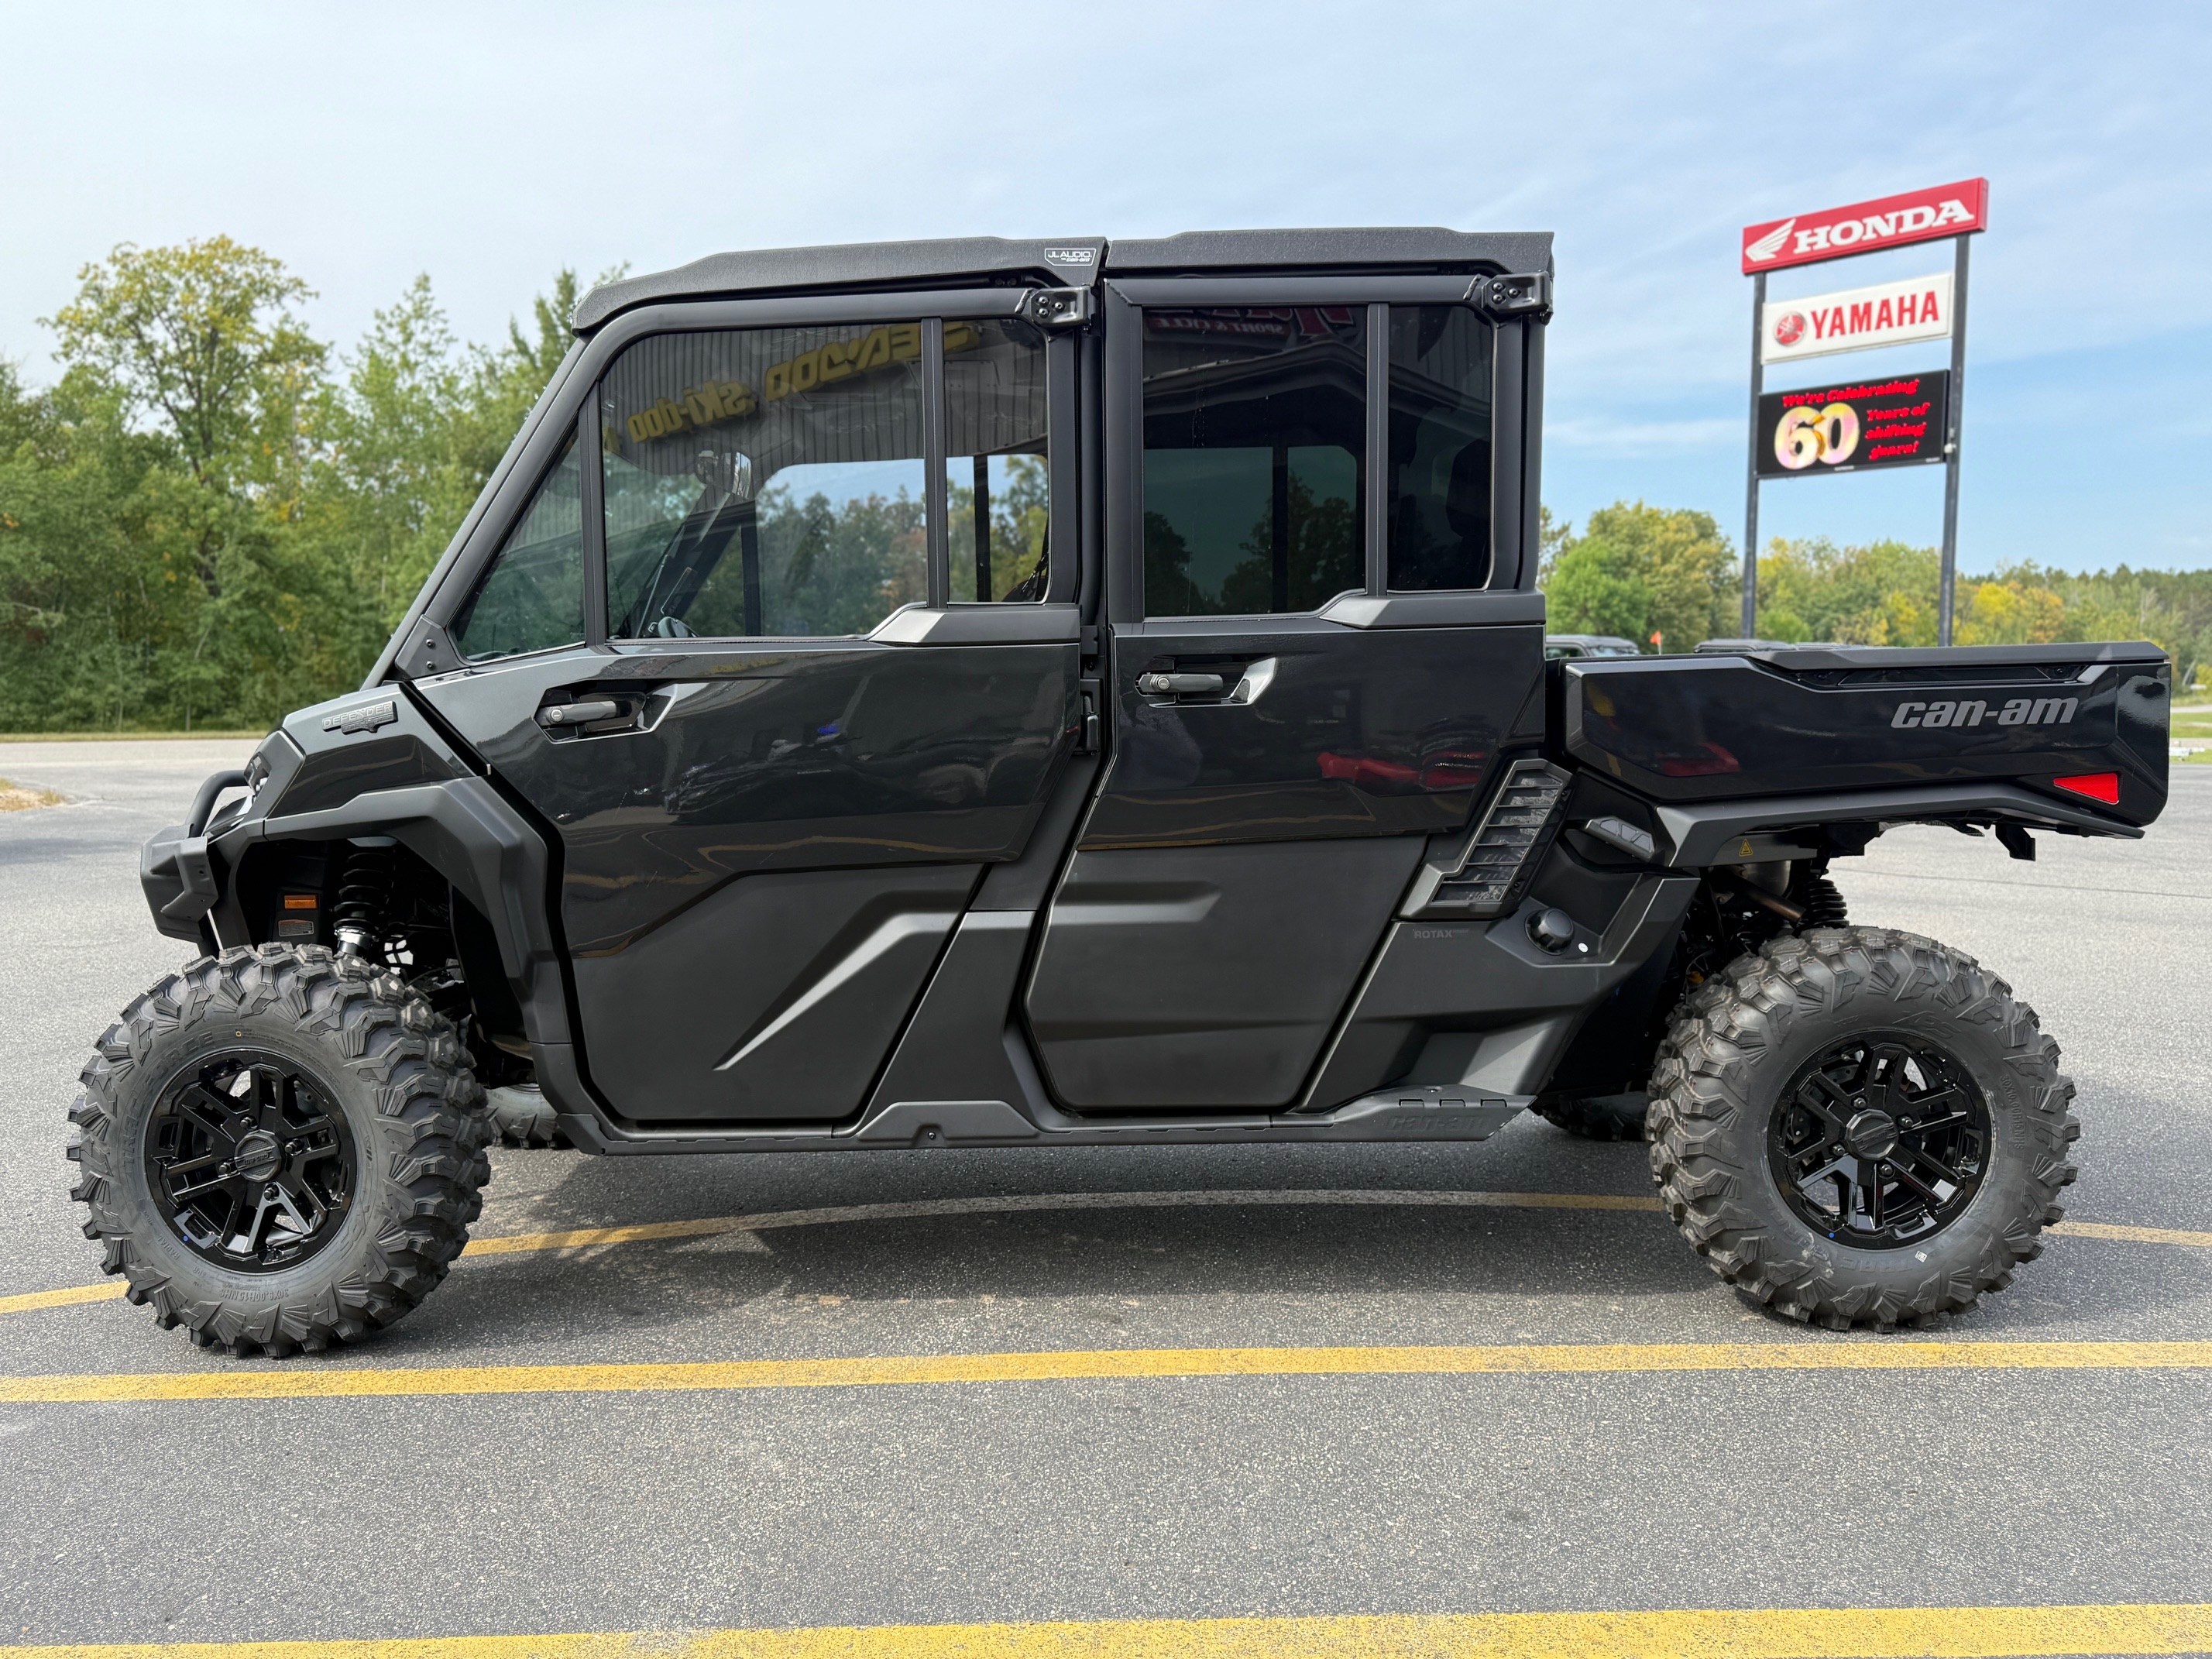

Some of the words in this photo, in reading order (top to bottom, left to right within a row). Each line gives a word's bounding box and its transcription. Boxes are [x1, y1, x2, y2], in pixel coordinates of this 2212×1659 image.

[1793, 199, 1974, 255] HONDA
[1048, 250, 1060, 259] JL
[1811, 290, 1940, 339] YAMAHA
[1782, 392, 1826, 408] We're
[1827, 378, 1920, 403] Celebrating
[1867, 407, 1910, 422] Years
[1911, 401, 1932, 416] of
[1774, 402, 1860, 470] 60
[1864, 421, 1928, 441] shifting
[1868, 440, 1920, 461] gears!
[323, 703, 393, 727] DEFENDER
[1891, 697, 2079, 729] can-am
[1413, 929, 1453, 939] ROTAX
[1387, 1114, 1488, 1132] can-am
